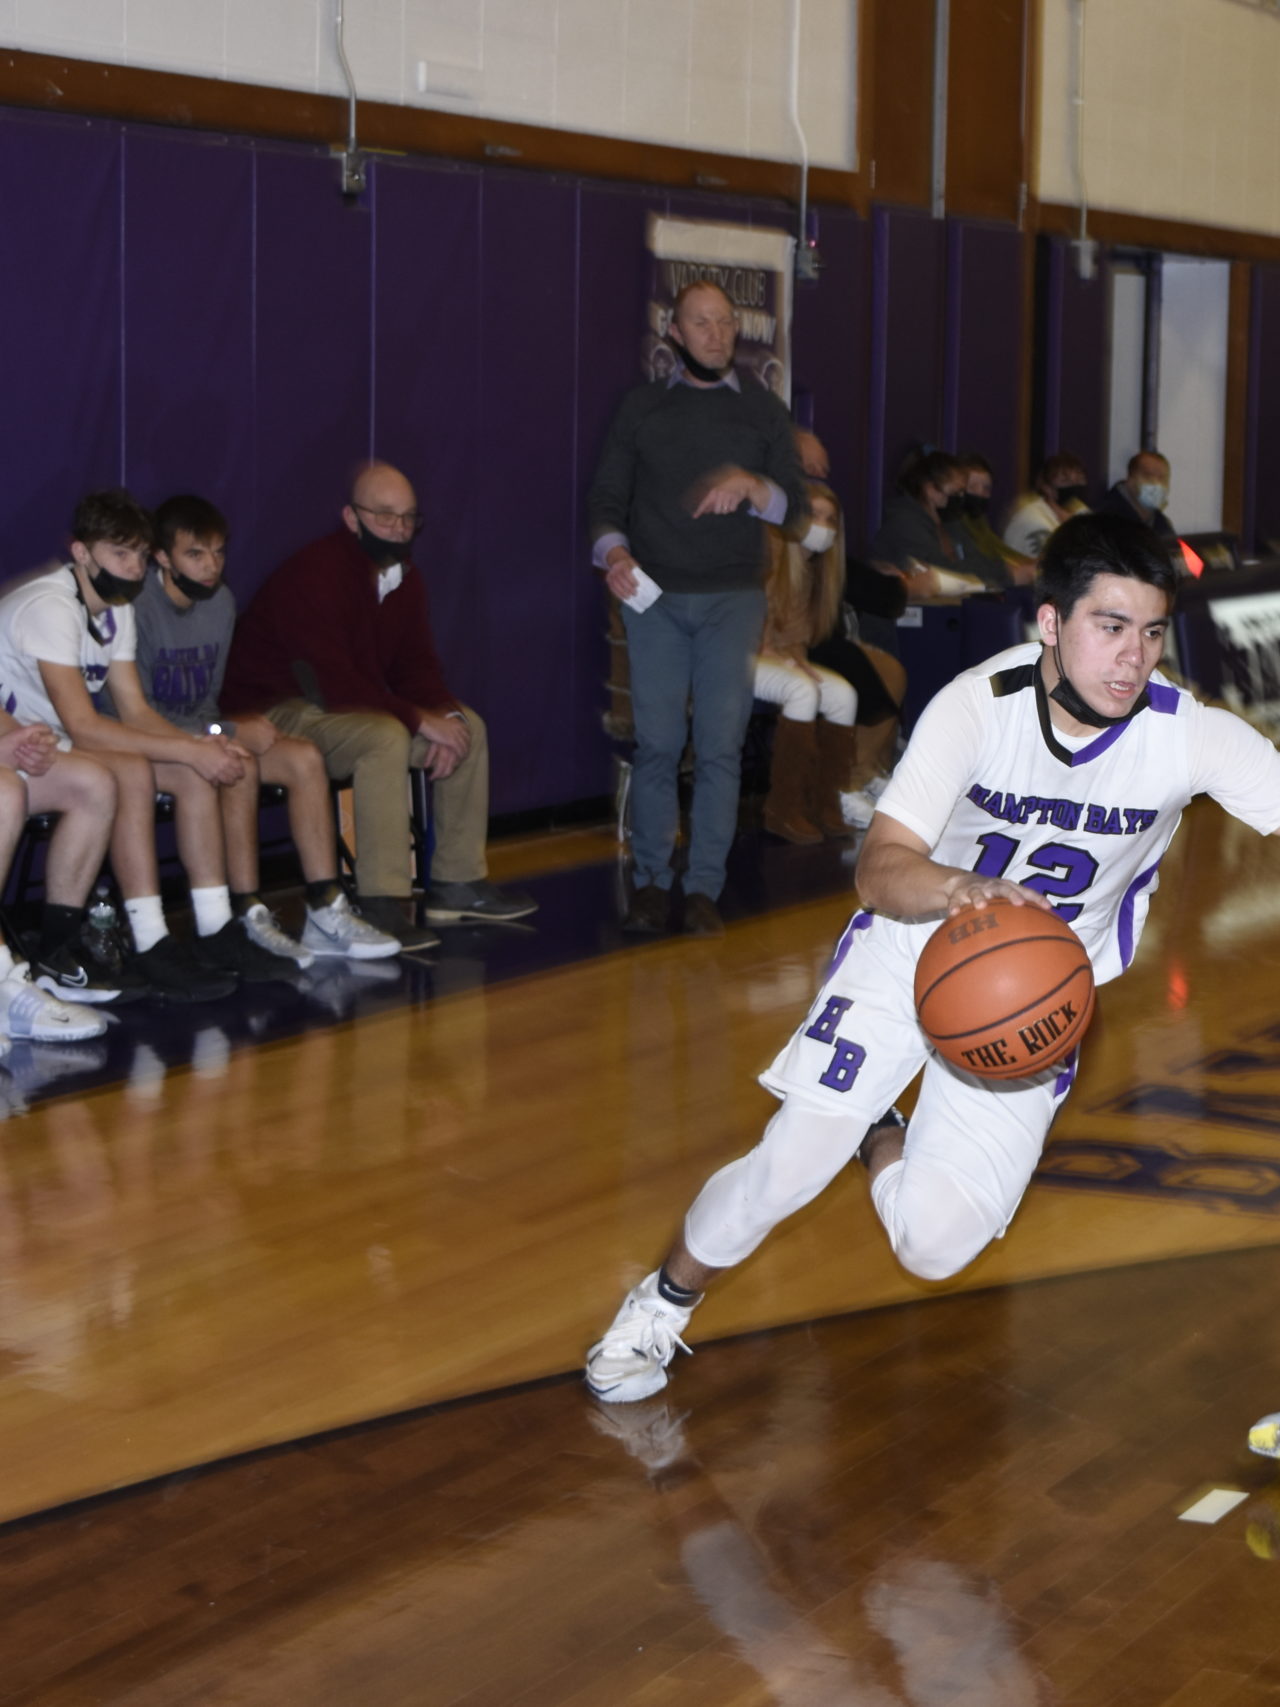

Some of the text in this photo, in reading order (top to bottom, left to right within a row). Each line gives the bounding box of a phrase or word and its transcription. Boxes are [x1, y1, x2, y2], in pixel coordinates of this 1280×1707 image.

[734, 269, 767, 306] CLUB
[966, 783, 1159, 835] HAMPTON BAYS
[972, 831, 1100, 923] 12
[961, 1001, 1079, 1068] THE ROCK
